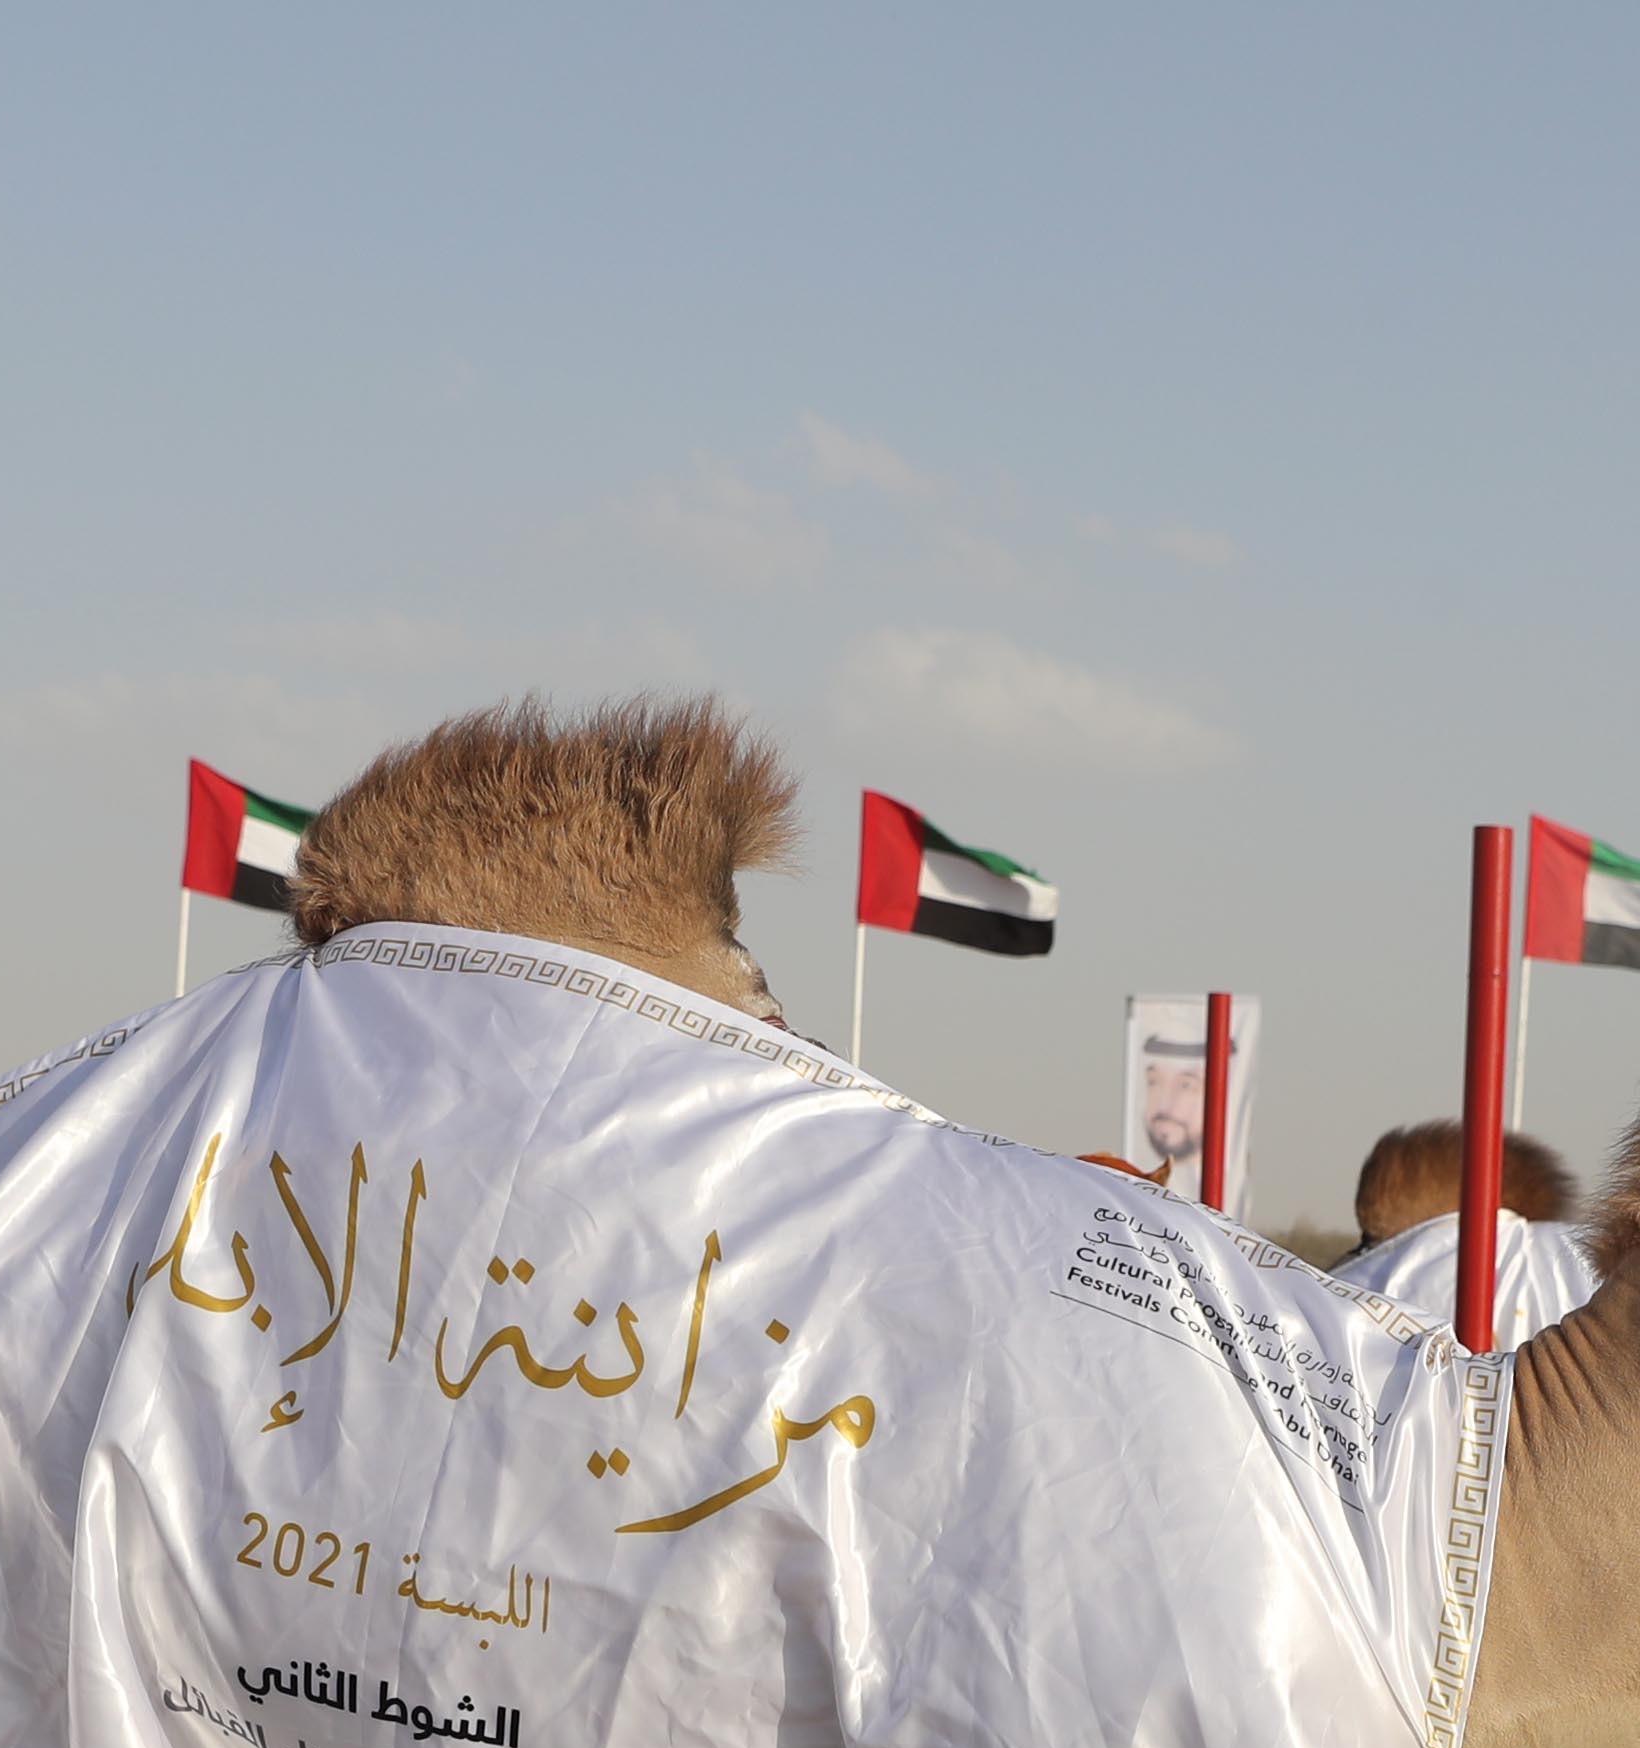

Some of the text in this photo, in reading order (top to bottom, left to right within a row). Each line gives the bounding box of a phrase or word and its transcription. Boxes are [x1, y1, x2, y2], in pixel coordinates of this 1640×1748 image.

[1075, 1246, 1172, 1291] Cultural
[127, 1131, 876, 1534] مزاينة الإبل
[1067, 1266, 1161, 1313] Festivals
[1316, 1441, 1360, 1487] Dhai
[236, 1512, 371, 1595] 2021
[237, 1660, 521, 1748] الشوط الثاني
